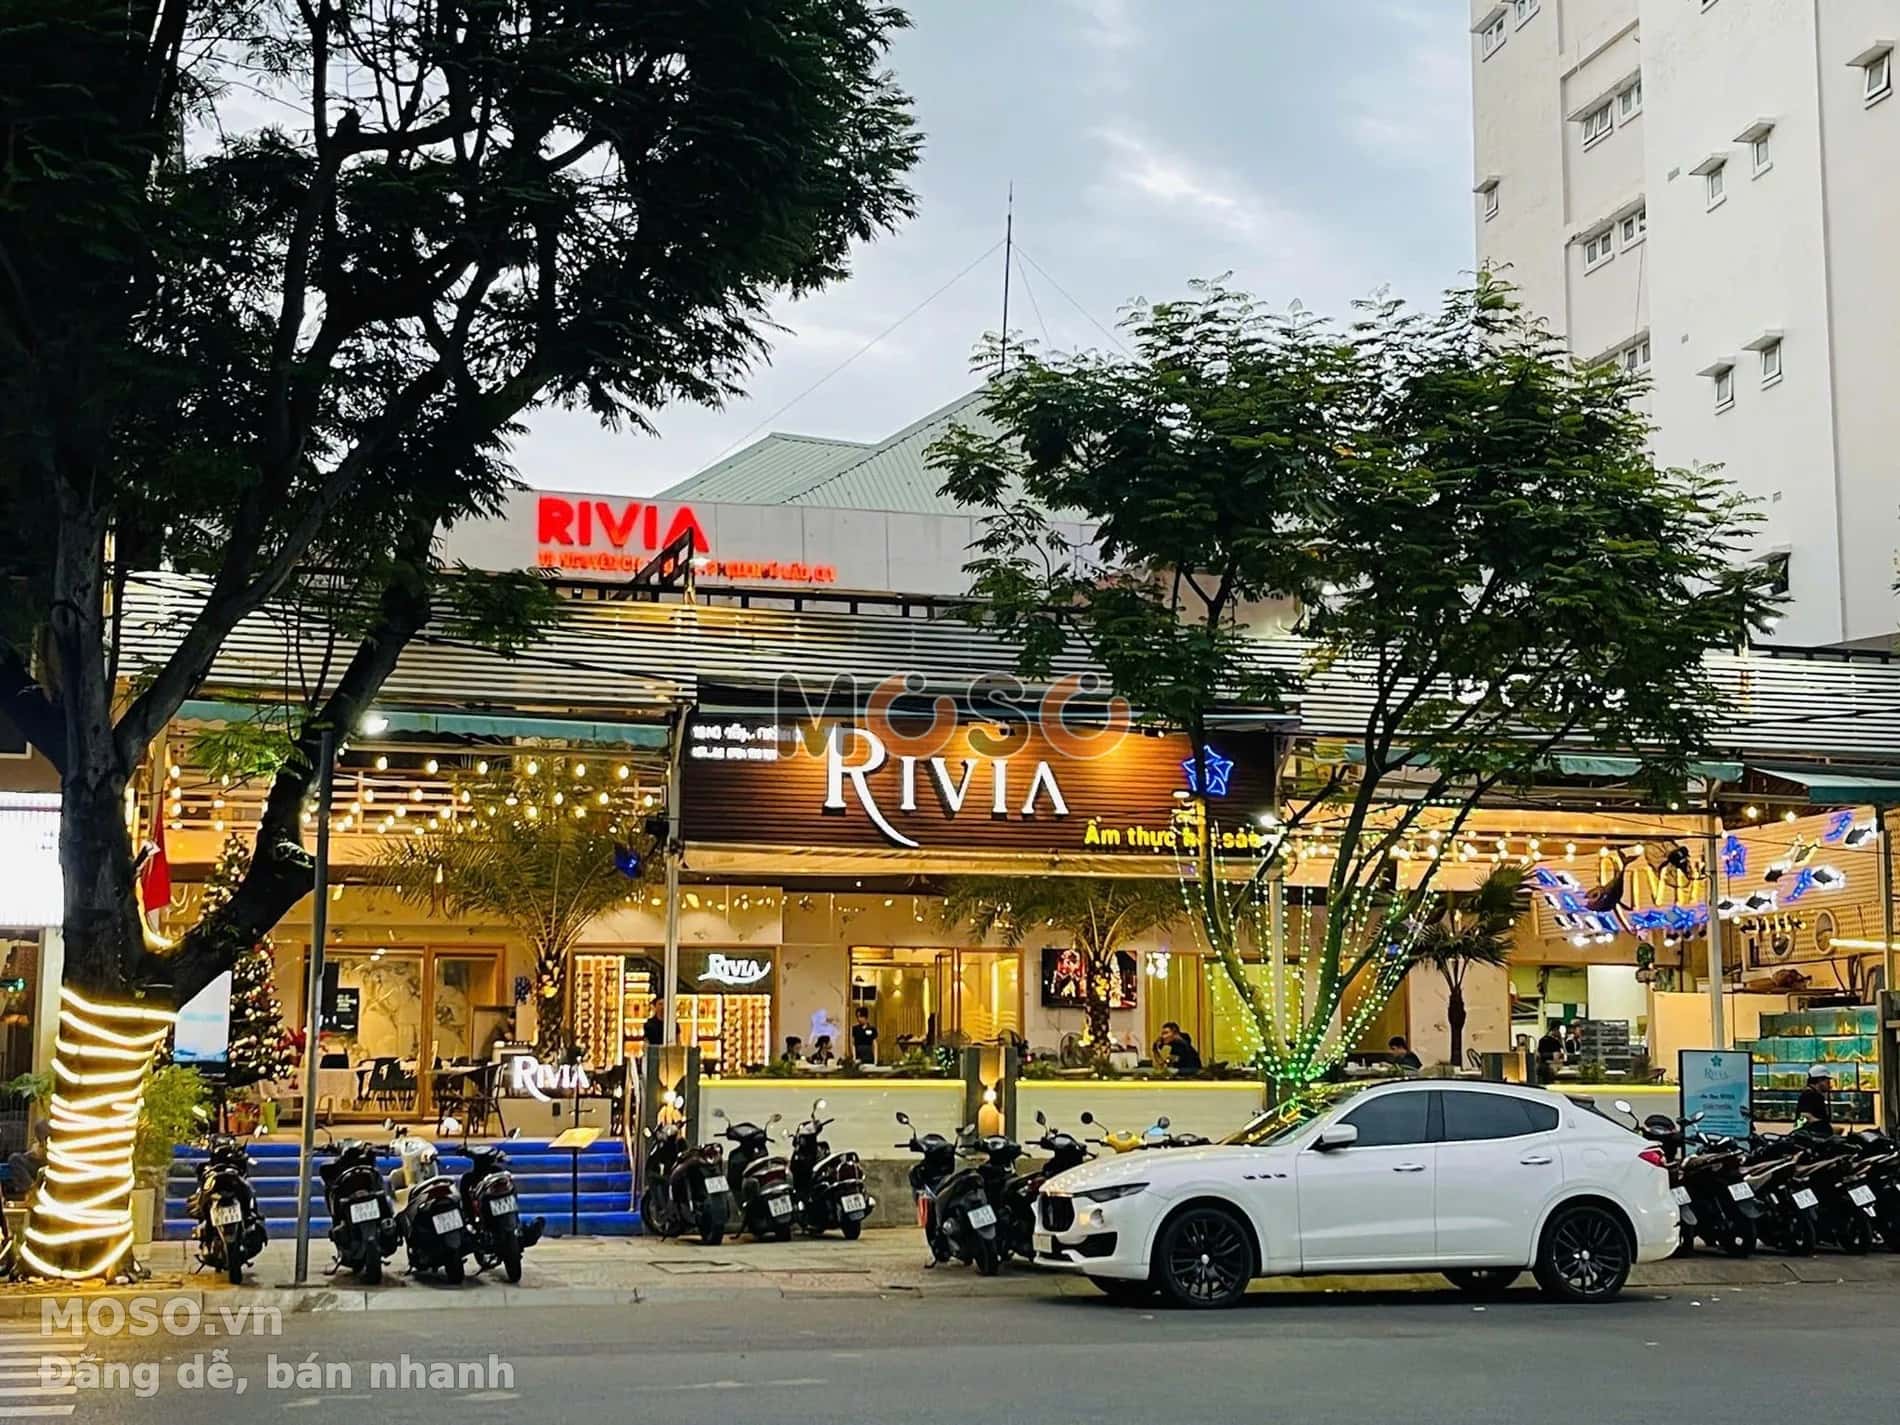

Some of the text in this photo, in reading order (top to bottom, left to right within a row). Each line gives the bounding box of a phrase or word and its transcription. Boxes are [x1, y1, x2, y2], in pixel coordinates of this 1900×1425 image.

[538, 496, 709, 552] RIVIA
[823, 726, 1069, 848] RIVIA
[697, 953, 770, 984] RIVIA
[513, 1055, 590, 1102] RIVIA
